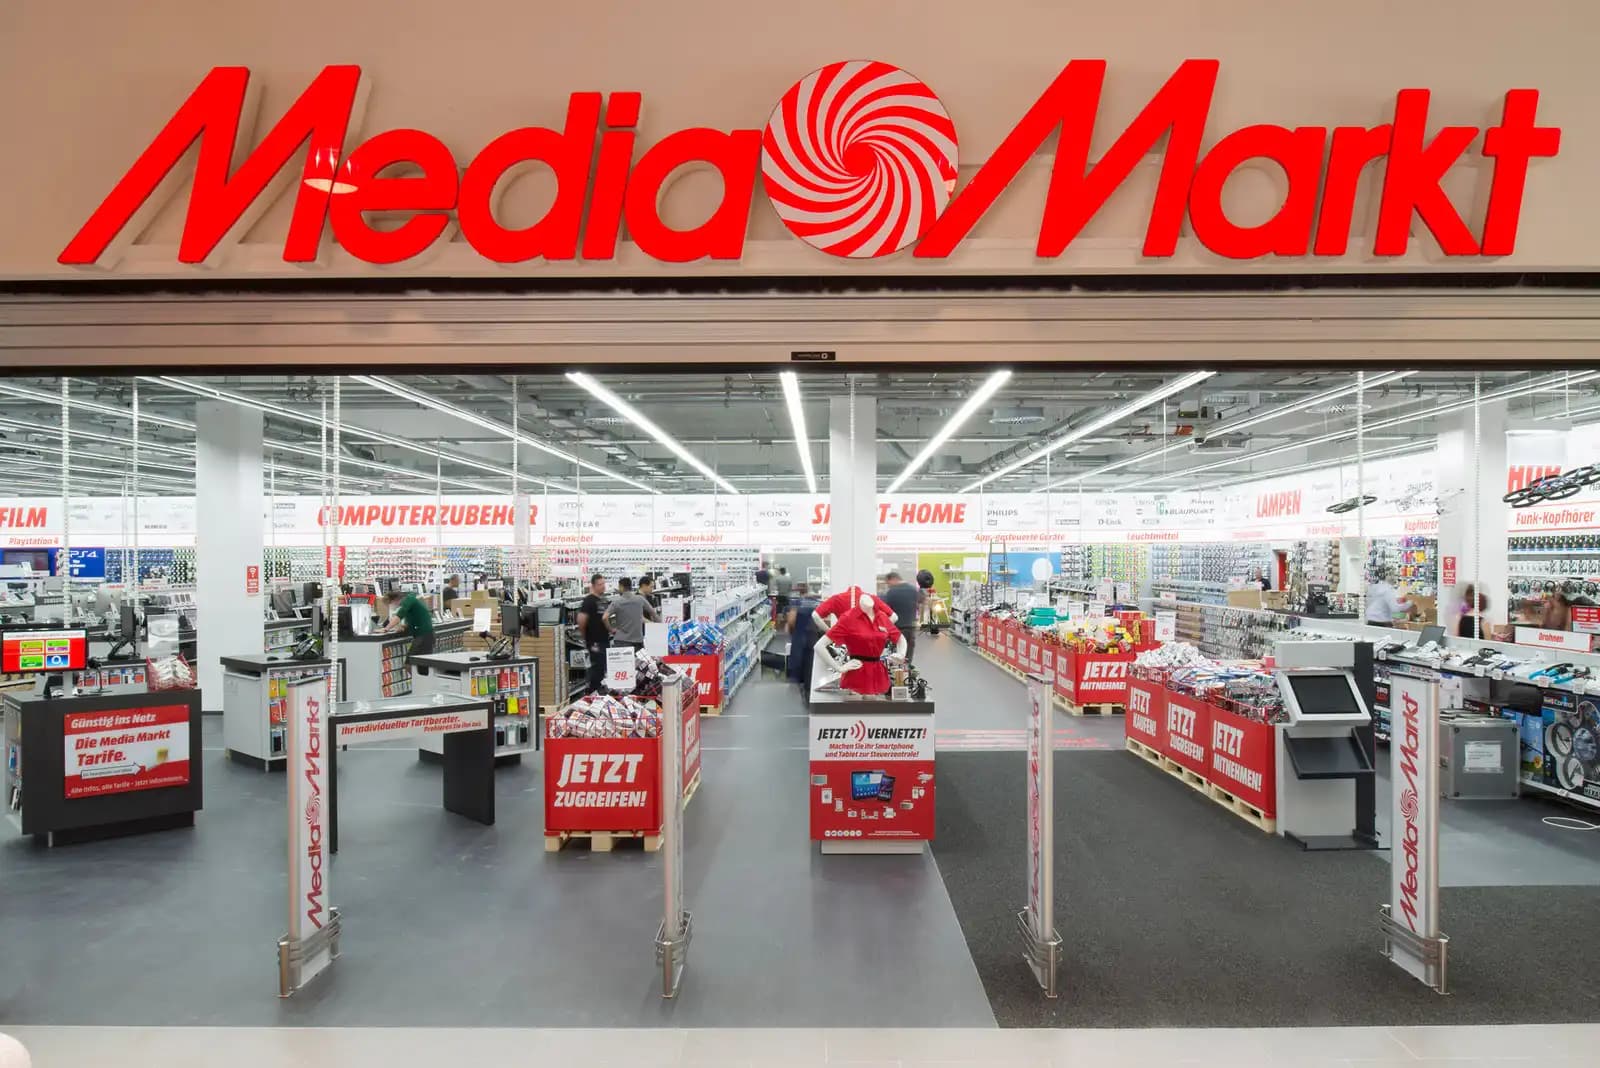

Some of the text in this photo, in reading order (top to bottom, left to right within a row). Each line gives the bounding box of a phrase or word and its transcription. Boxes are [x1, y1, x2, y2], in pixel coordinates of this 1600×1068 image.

[57, 59, 1561, 263] Media Markt
[1256, 489, 1302, 518] LAMPEN
[8, 537, 59, 546] Playstation 4
[372, 536, 426, 544] Farbpatronen
[662, 535, 723, 543] Computerkabel
[1127, 532, 1179, 540] Leuchtmittel
[70, 550, 97, 558] PS4
[1538, 632, 1564, 642] Drohnen
[1082, 661, 1127, 681] JETZT
[1130, 687, 1151, 715] JETZT
[71, 713, 157, 729] Günstig ins Netz
[341, 715, 460, 735] Ihr individueller Tarifberater.
[1132, 713, 1157, 737] KAUFEN!
[1167, 702, 1197, 738] JETZT
[75, 729, 171, 750] Die Media Markt
[817, 728, 927, 741] JETZT VERNETZT!
[1212, 720, 1244, 758] JETZT
[875, 743, 914, 751] Smartphone
[1169, 733, 1204, 762] ZUGREIFEN!
[77, 750, 127, 766] Tarife.
[557, 753, 644, 788] JETZT
[1213, 752, 1263, 792] MITNEHMEN!
[554, 790, 648, 808] ZUGREIFEN!
[1400, 690, 1420, 932] Media Markt
